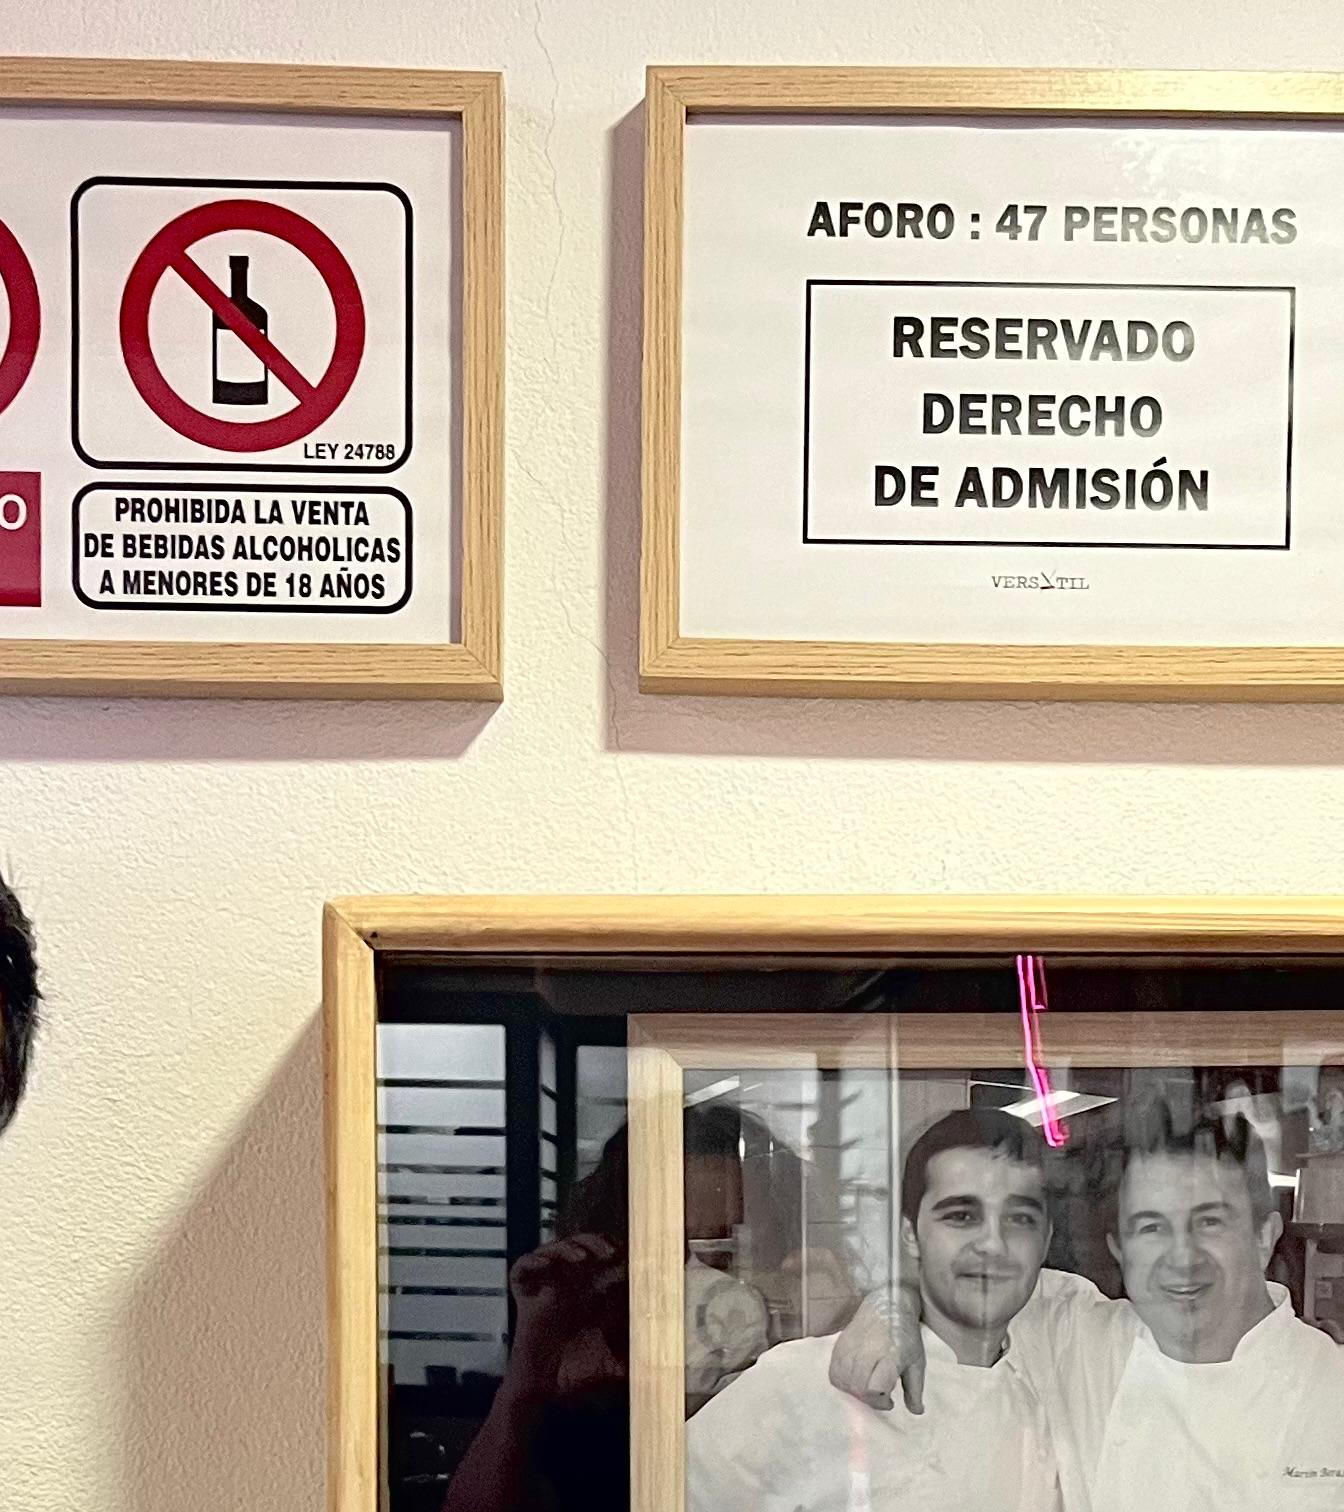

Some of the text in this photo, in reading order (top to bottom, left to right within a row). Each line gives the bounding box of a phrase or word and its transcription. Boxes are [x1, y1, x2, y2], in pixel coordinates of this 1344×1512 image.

[806, 201, 956, 240] AFORO
[995, 204, 1048, 241] 47
[1063, 205, 1298, 244] PERSONAS
[893, 316, 1196, 362] RESERVADO
[922, 392, 1164, 438] DERECHO
[302, 442, 397, 460] LEY 24788
[874, 456, 1210, 511] DE ADMISIÓN
[114, 496, 370, 527] PROHIBIDA LA VENTA
[84, 532, 402, 564] DE BEBIDAS ALCOHOLICAS
[99, 566, 386, 600] A MENORES DE 18 AÑOS
